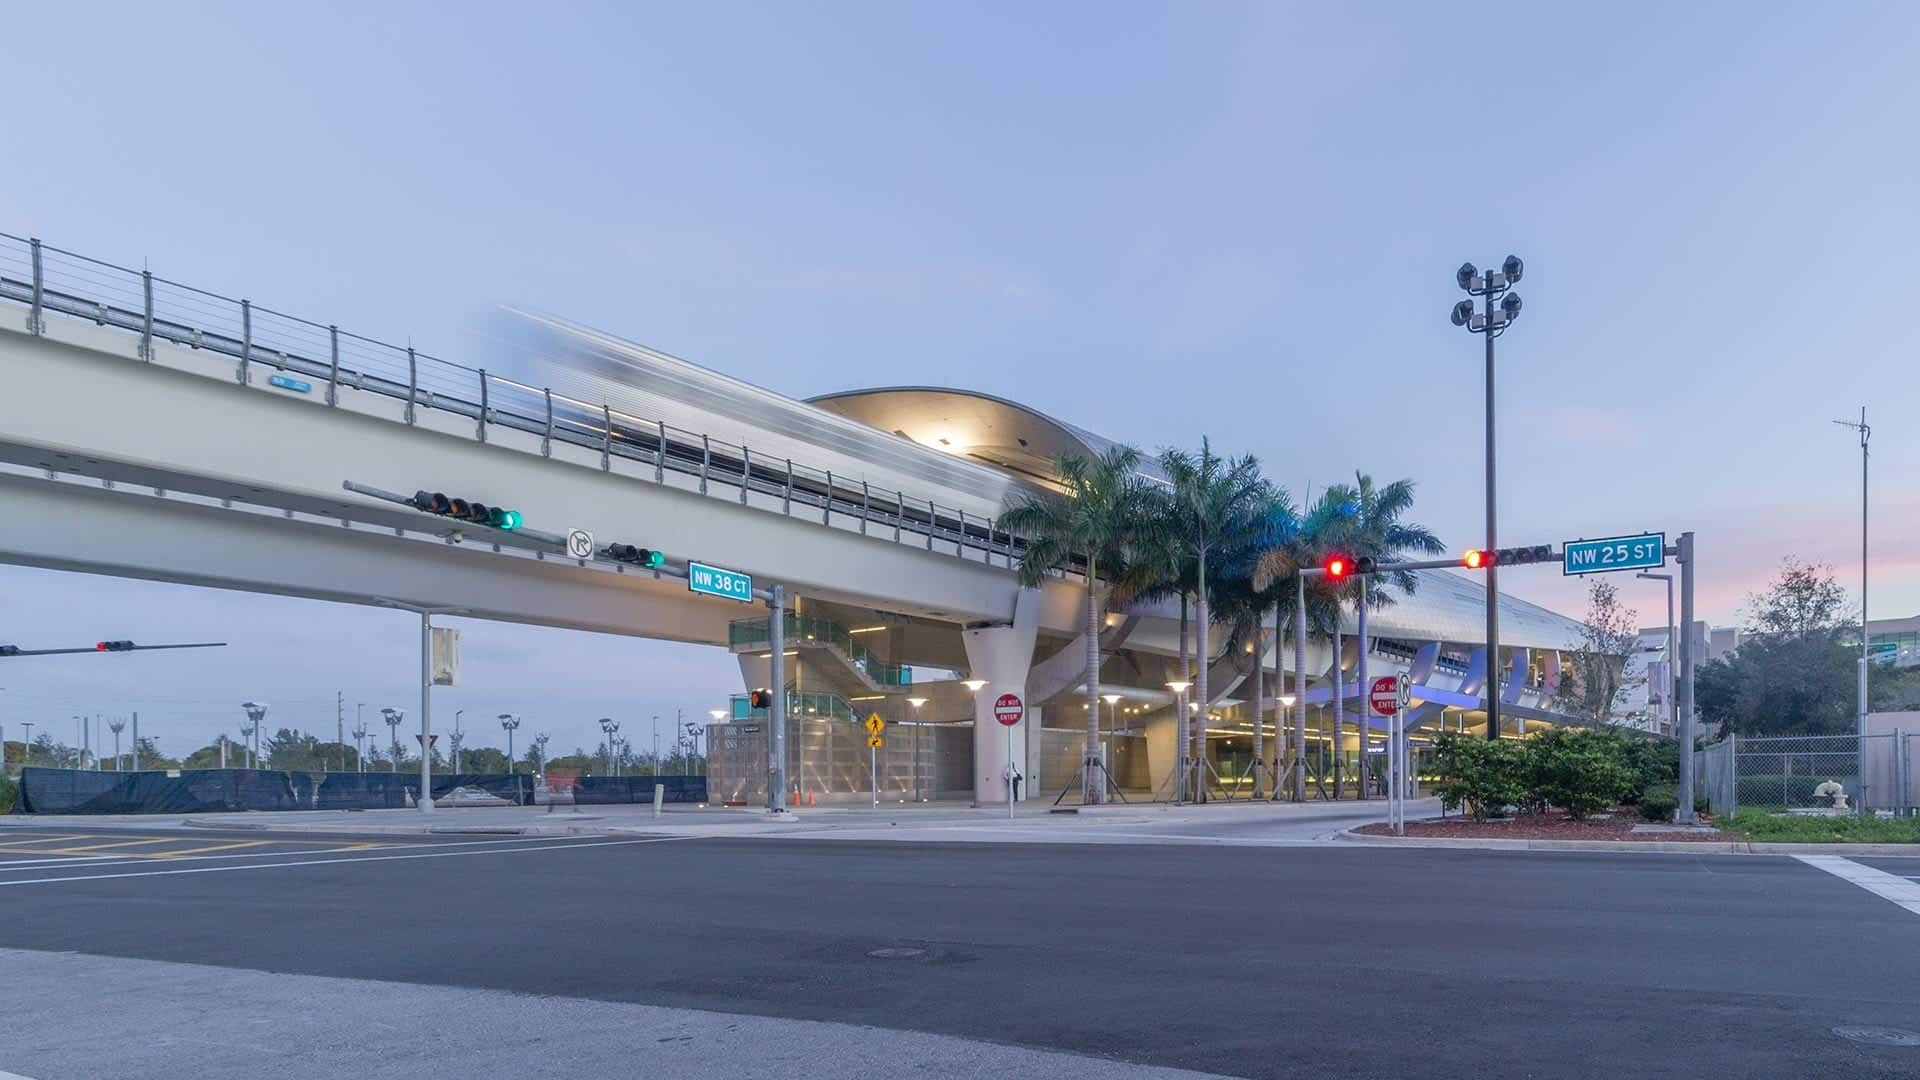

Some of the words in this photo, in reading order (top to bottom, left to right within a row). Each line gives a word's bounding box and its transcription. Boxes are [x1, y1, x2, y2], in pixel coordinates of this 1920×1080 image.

[1572, 549, 1597, 565] NW
[1602, 545, 1629, 564] 25
[1634, 543, 1655, 560] ST
[695, 570, 712, 587] NW
[715, 574, 732, 592] 38
[734, 580, 747, 593] CT
[1375, 684, 1386, 692] DO
[1378, 701, 1396, 709] ENTE
